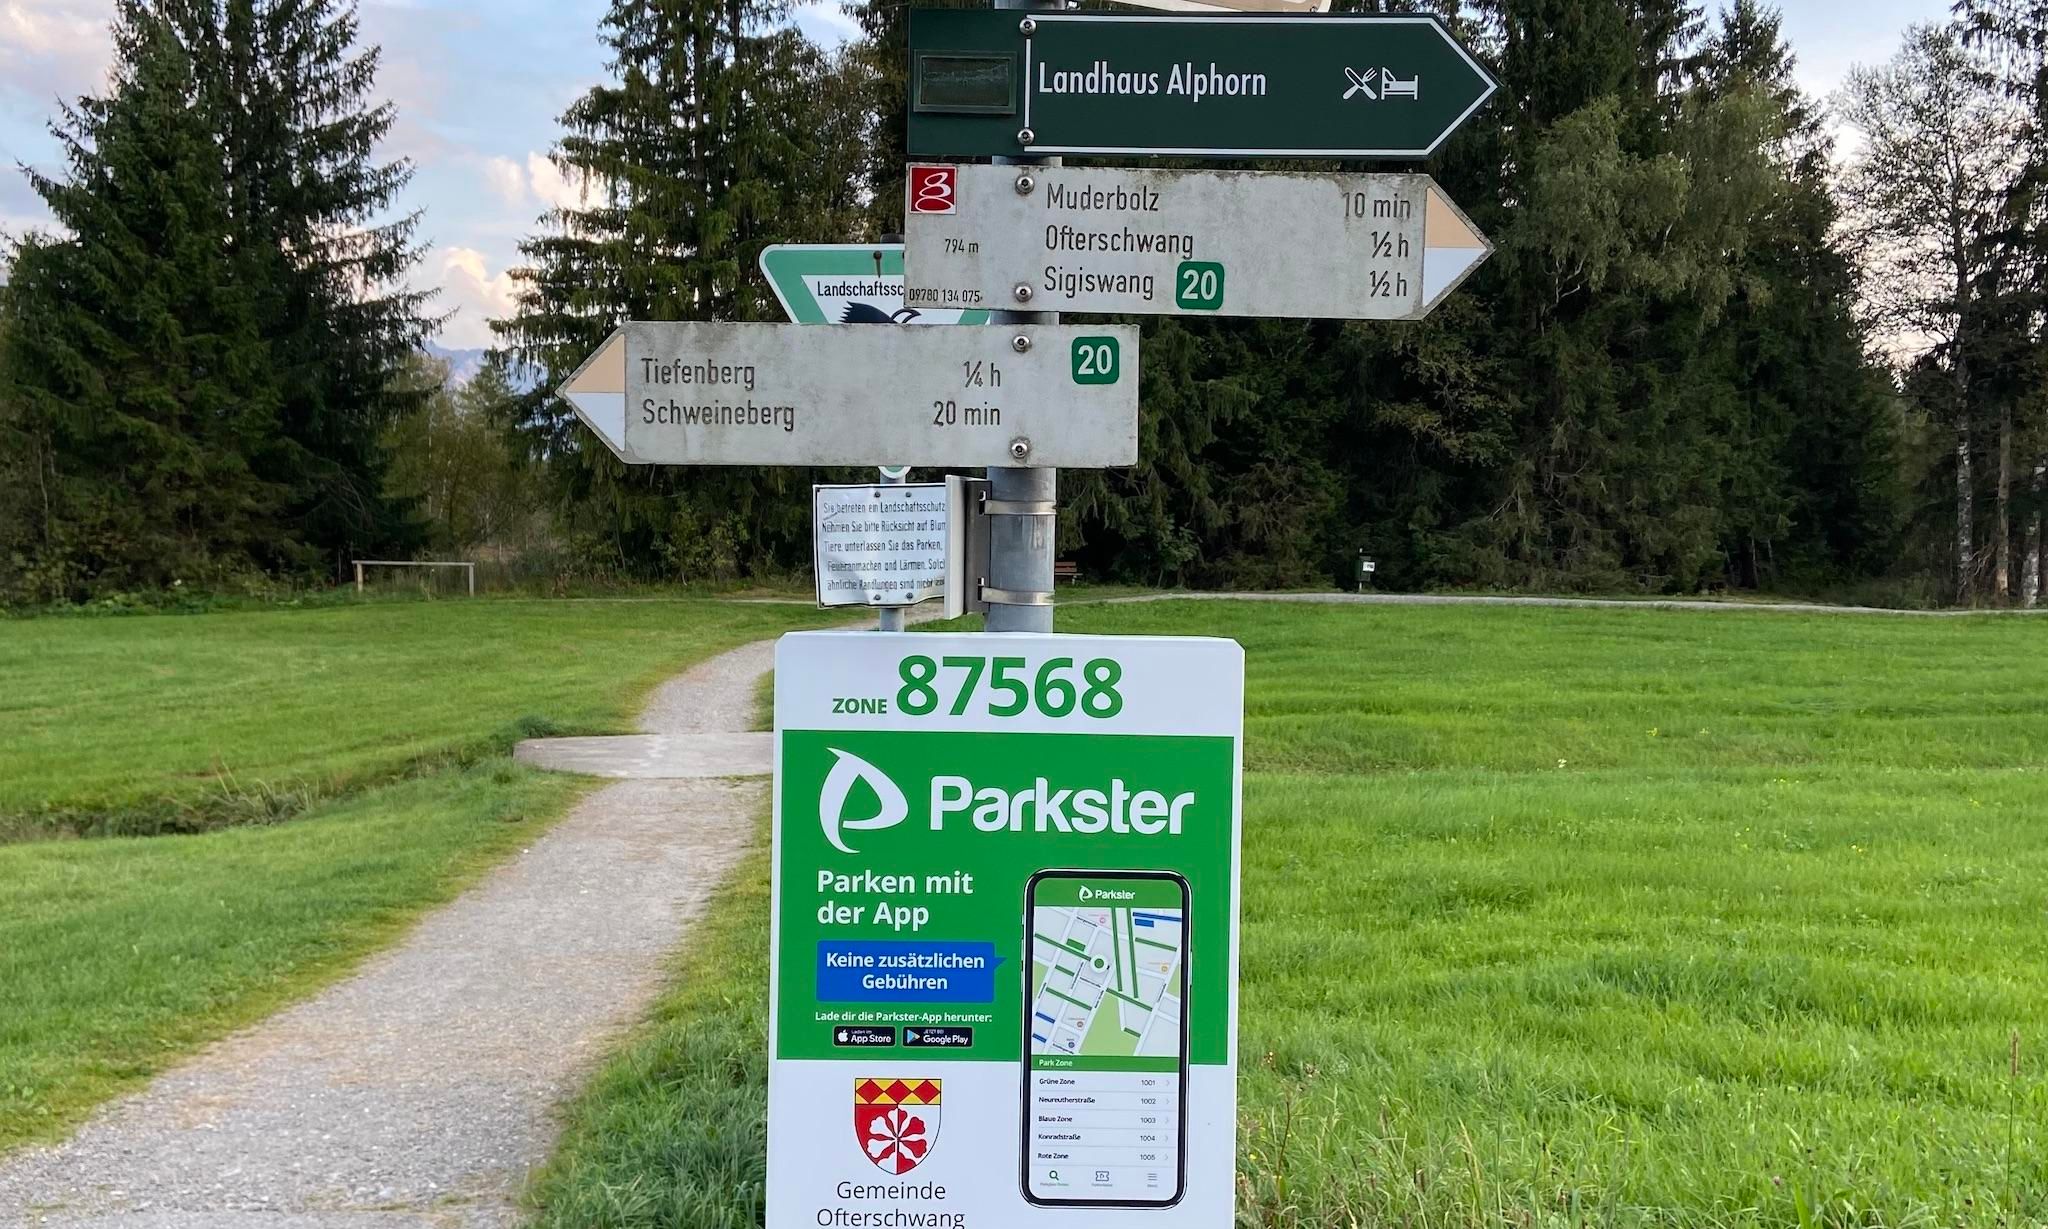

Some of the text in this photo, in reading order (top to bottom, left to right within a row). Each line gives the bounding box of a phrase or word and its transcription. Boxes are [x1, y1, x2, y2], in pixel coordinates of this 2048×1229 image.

[1039, 61, 1267, 103] Landhaus Alphorn
[1047, 182, 1160, 212] Muderbolz
[1342, 192, 1411, 219] 10 min
[945, 238, 979, 254] 794 m
[1045, 224, 1194, 260] Ofterschwang
[1397, 232, 1409, 258] h
[1044, 265, 1218, 300] Sigiswang 20
[1396, 272, 1407, 297] h
[909, 288, 939, 302] 09780
[941, 289, 959, 303] 134
[1077, 344, 1113, 375] 20
[641, 358, 755, 392] Tiefenberg
[990, 362, 1001, 387] h
[642, 398, 794, 432] Schweineberg
[933, 400, 1001, 427] 20 min
[823, 502, 835, 514] Sie
[836, 503, 866, 513] betreten
[868, 504, 879, 513] ein
[822, 521, 850, 532] Nehmen
[851, 521, 863, 532] Sie
[864, 520, 880, 532] bitte
[916, 520, 928, 531] auf
[844, 541, 886, 552] unterlassen
[888, 540, 899, 551] Sie
[901, 540, 914, 551] das
[884, 560, 897, 571] und
[899, 579, 914, 590] sind
[832, 655, 1123, 719] ZONE 87568
[930, 775, 1195, 835] Parkster
[817, 870, 974, 894] Parken mit
[1095, 889, 1135, 900] Parkster
[817, 901, 930, 931] der App
[826, 952, 985, 969] Keine zusätzlichen
[862, 974, 948, 990] Gebühren
[815, 1012, 993, 1024] Lade dir die Parkster-App herunter:
[851, 1034, 892, 1044] App Store
[923, 1034, 969, 1045] Google Play
[1039, 1058, 1073, 1067] Park Zone
[1039, 1077, 1075, 1086] Grüne Zone
[1141, 1097, 1156, 1105] 1002
[1038, 1115, 1073, 1123] Blaue Zone
[1140, 1116, 1156, 1124] 1003
[1037, 1152, 1069, 1160] Rote Zone
[836, 1181, 946, 1200] Gemeinde
[816, 1207, 966, 1229] Ofterschwang
